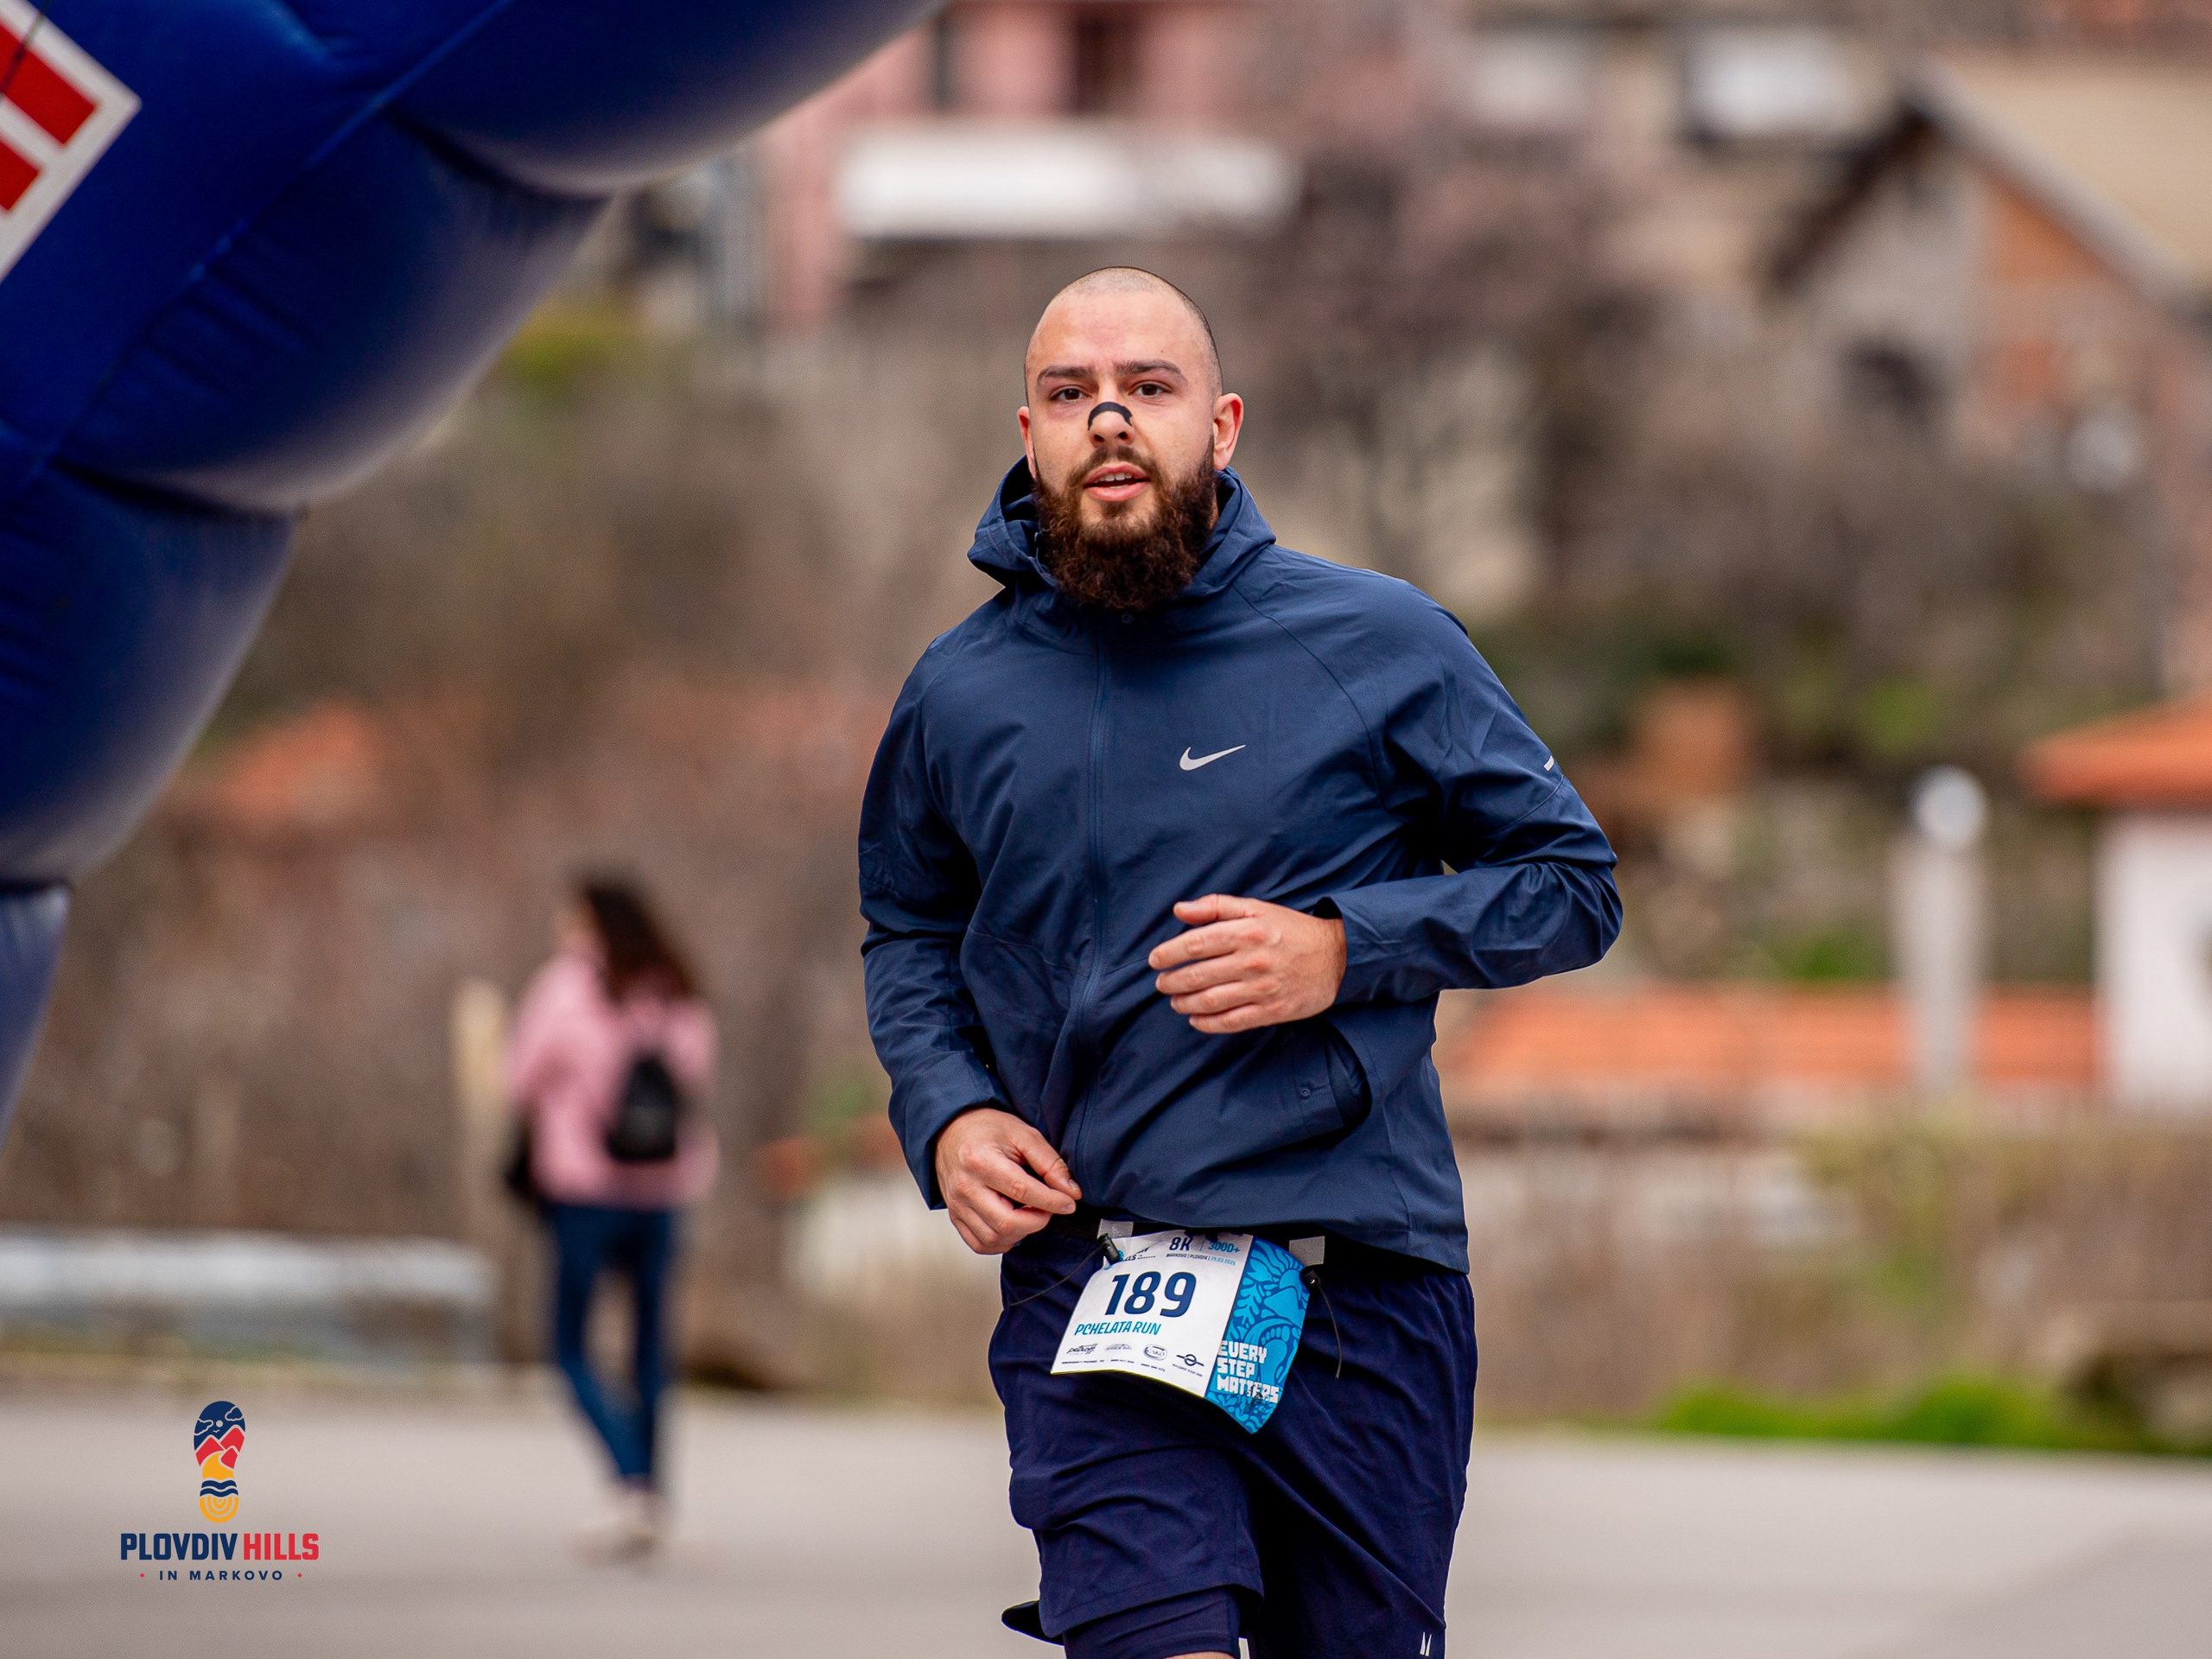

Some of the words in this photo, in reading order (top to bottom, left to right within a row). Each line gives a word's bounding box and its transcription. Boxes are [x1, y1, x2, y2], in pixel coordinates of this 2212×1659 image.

[1169, 1236, 1193, 1251] 8K
[1208, 1241, 1240, 1254] 300D+
[1104, 1271, 1197, 1318] 189
[1074, 1320, 1132, 1336] PCHELATA
[1132, 1321, 1161, 1336] RUN
[1217, 1340, 1268, 1363] EVERY
[1217, 1357, 1255, 1378] STEP
[1217, 1374, 1279, 1403] MATTERS
